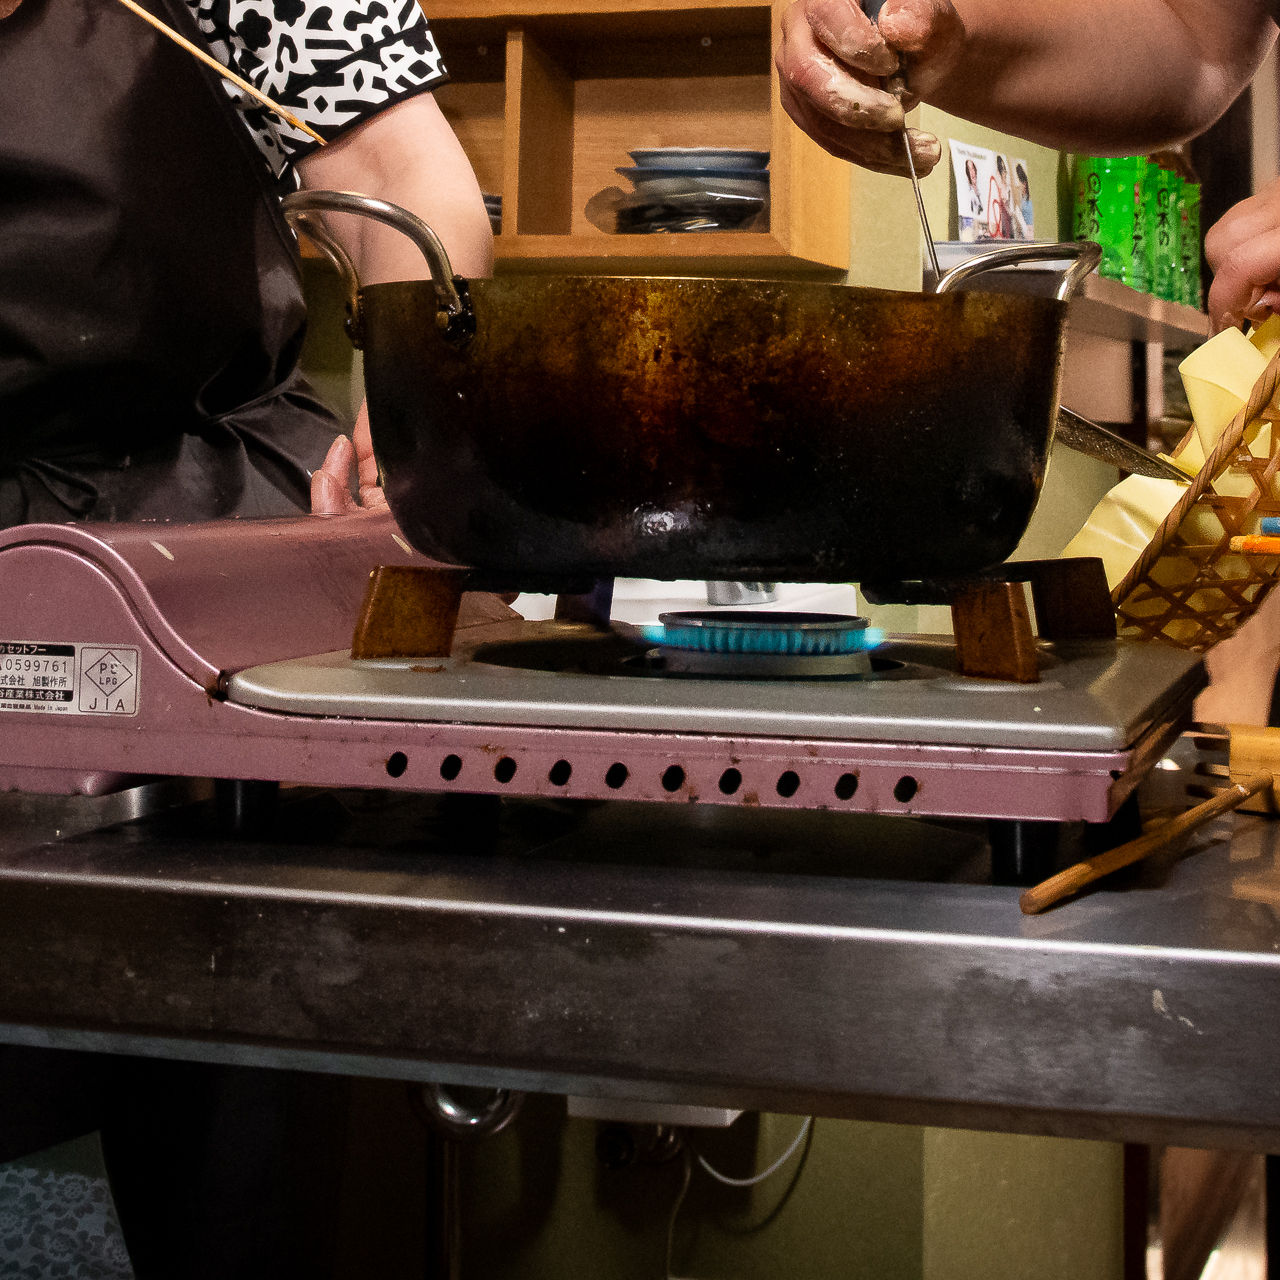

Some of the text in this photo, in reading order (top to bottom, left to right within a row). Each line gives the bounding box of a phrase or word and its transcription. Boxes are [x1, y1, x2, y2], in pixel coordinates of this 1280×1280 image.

[32, 676, 68, 688] 旭製作所
[99, 677, 118, 686] LPG
